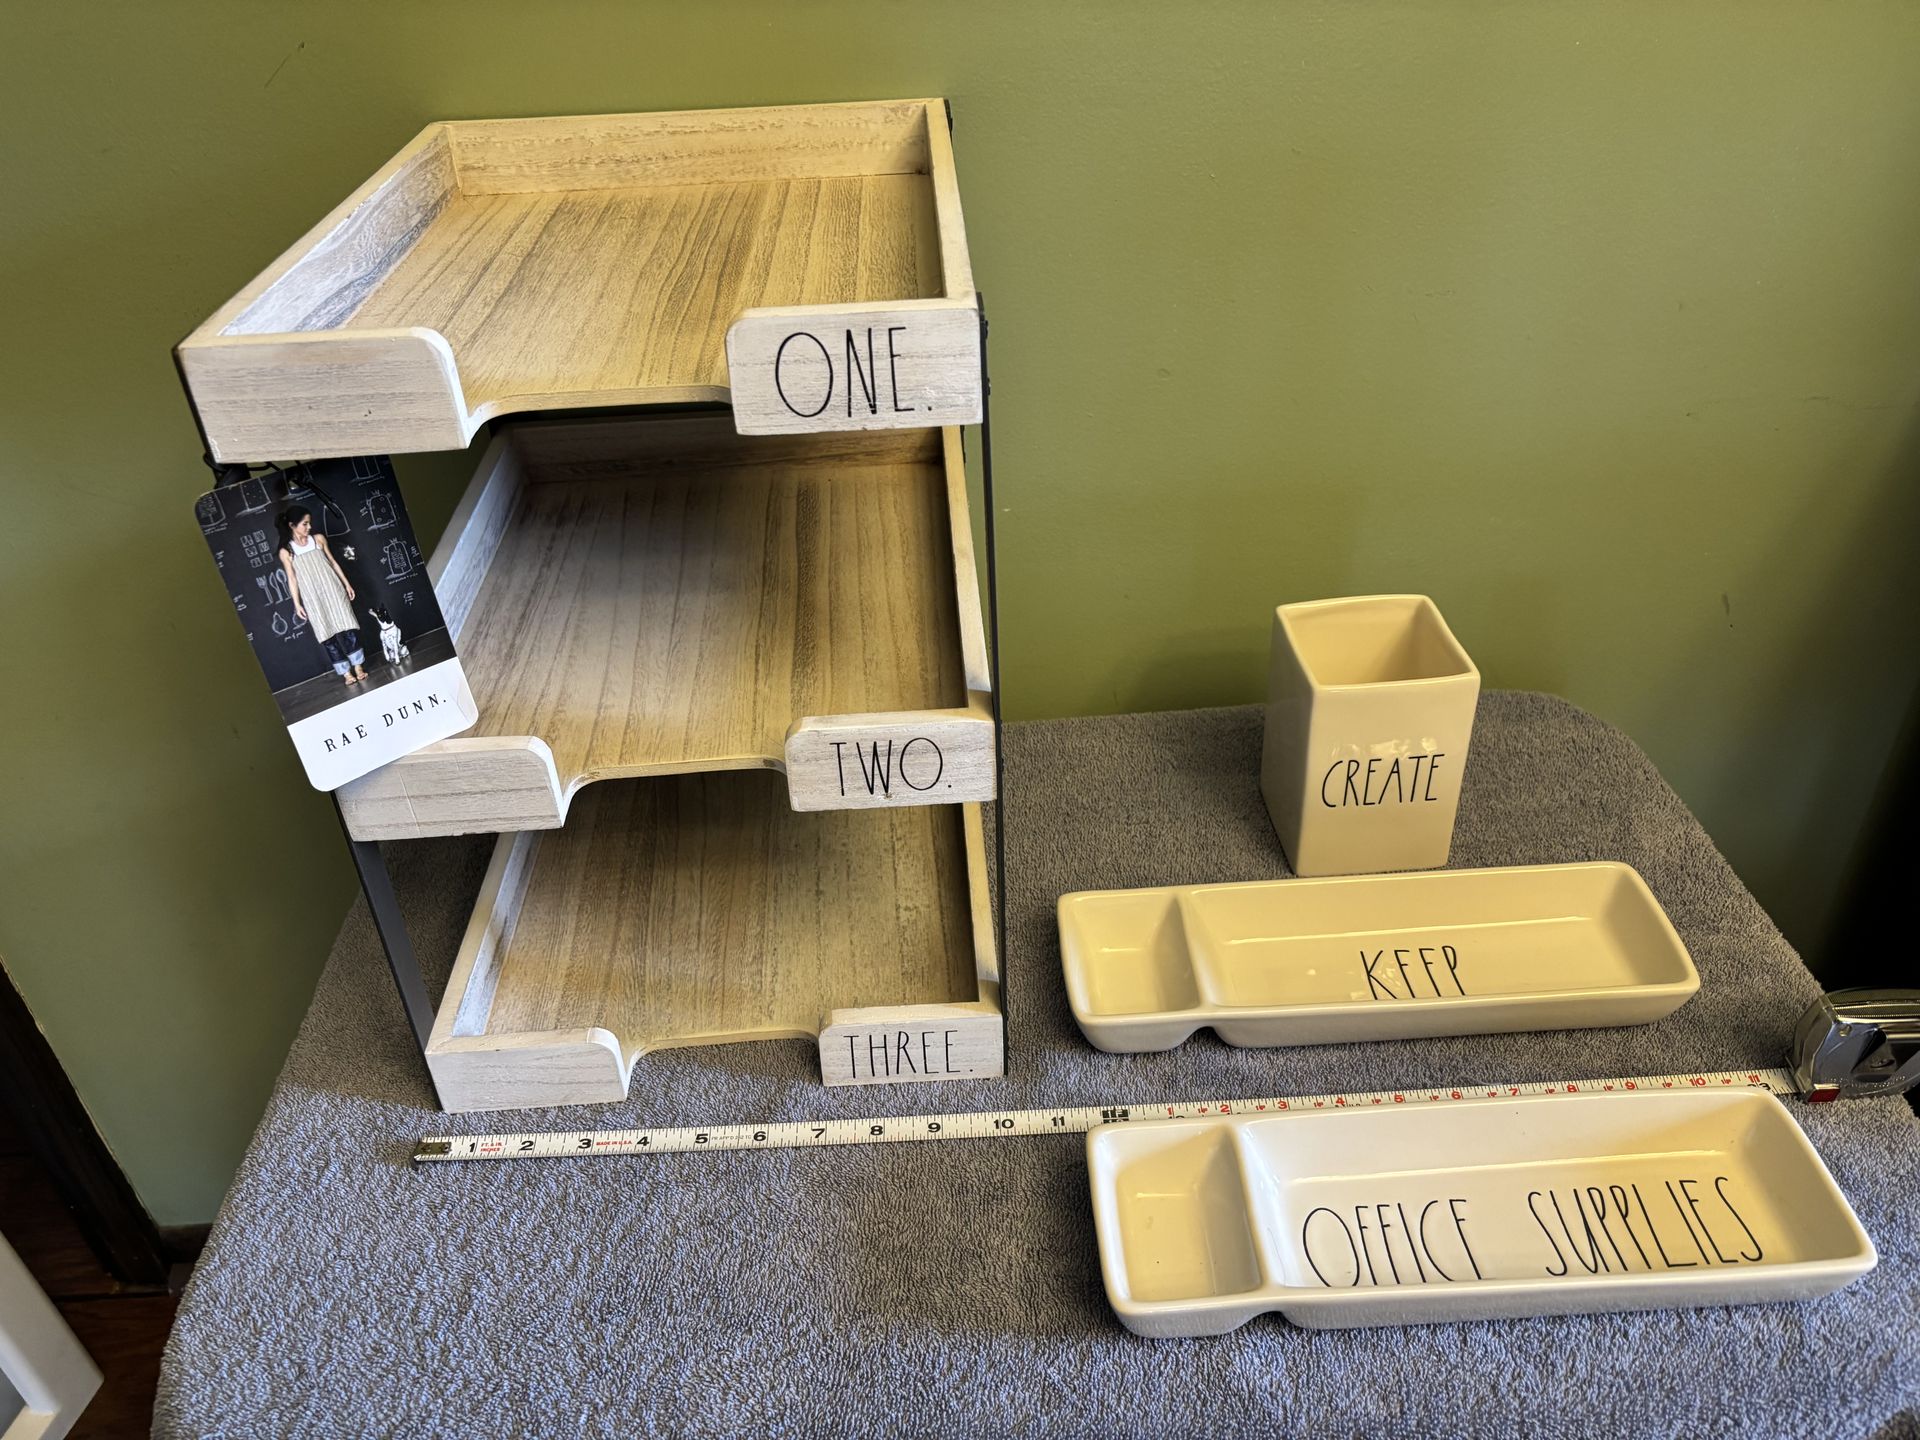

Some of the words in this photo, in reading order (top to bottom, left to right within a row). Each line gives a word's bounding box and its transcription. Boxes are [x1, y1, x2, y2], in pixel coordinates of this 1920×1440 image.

[774, 326, 933, 418] ONE.
[322, 724, 369, 753] RAE
[381, 692, 448, 728] DUNN.
[828, 736, 953, 797] TWO.
[1321, 753, 1446, 808] CREATE
[842, 1029, 975, 1080] THREE.
[1167, 1107, 1173, 1116] 1
[1219, 1104, 1230, 1113] 2
[1277, 1100, 1288, 1110] 3
[1335, 1096, 1346, 1106] 4
[1393, 1094, 1404, 1103] 5
[1451, 1090, 1461, 1100] 6
[1508, 1087, 1519, 1096] 7
[1566, 1084, 1578, 1093] 8
[1624, 1081, 1636, 1091] 9
[1688, 1077, 1706, 1087] 10
[1747, 1074, 1761, 1084] 11
[468, 1142, 476, 1153] 1
[519, 1140, 534, 1152] 2
[577, 1138, 592, 1149] 3
[636, 1135, 650, 1147] 4
[694, 1133, 709, 1144] 5
[753, 1130, 767, 1142] 6
[811, 1128, 826, 1139] 7
[869, 1125, 884, 1136] 8
[927, 1122, 942, 1133] 9
[993, 1118, 1015, 1130] 10
[1051, 1115, 1066, 1127] 11
[1302, 1198, 1483, 1288] OFFICE
[1527, 1176, 1764, 1277] SUPPLIES
